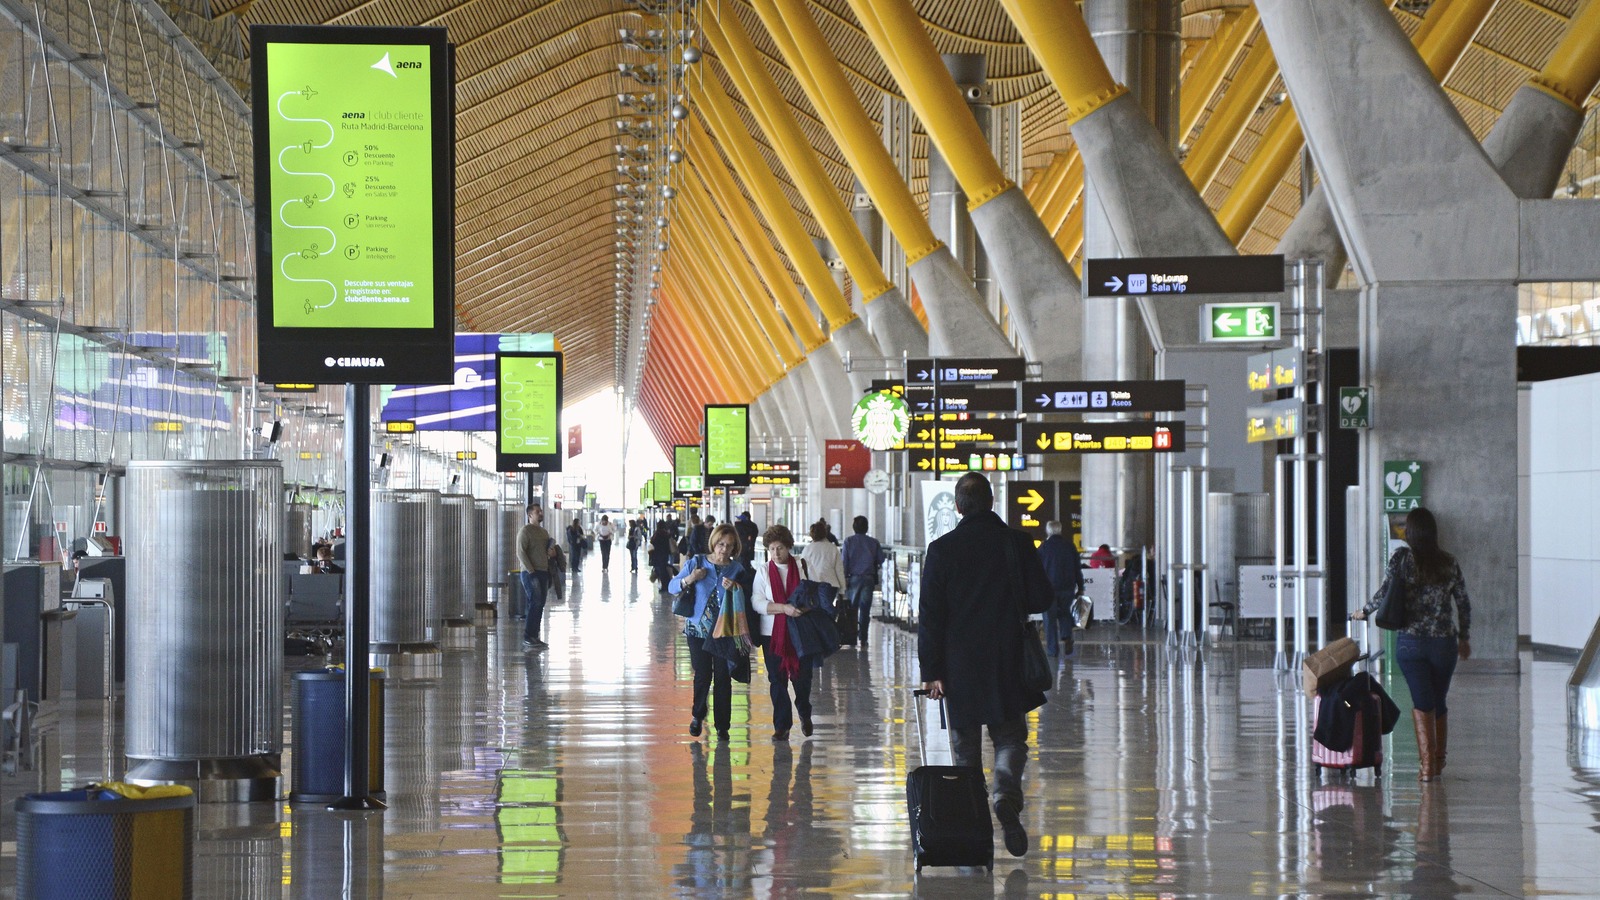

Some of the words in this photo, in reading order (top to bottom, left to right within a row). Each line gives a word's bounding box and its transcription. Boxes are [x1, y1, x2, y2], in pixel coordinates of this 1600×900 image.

[396, 60, 422, 69] aena
[341, 111, 365, 119] aena
[373, 111, 392, 120] club
[394, 111, 424, 120] cliente
[360, 123, 424, 131] Madrid-Barcelona
[1150, 273, 1162, 284] Vip
[1162, 273, 1189, 284] Lounge
[344, 279, 373, 287] Descubre
[387, 280, 414, 288] ventajas
[1130, 279, 1145, 288] VIP
[1152, 283, 1171, 292] Sala
[1172, 283, 1187, 293] Vip
[336, 357, 385, 367] CEMUSA
[1110, 390, 1131, 399] Toilets
[1111, 399, 1132, 407] Aseos
[1341, 418, 1368, 427] DEA
[1073, 432, 1093, 441] Gates
[1157, 433, 1169, 447] H
[1073, 440, 1102, 449] Puertas
[1385, 498, 1420, 510] DEA
